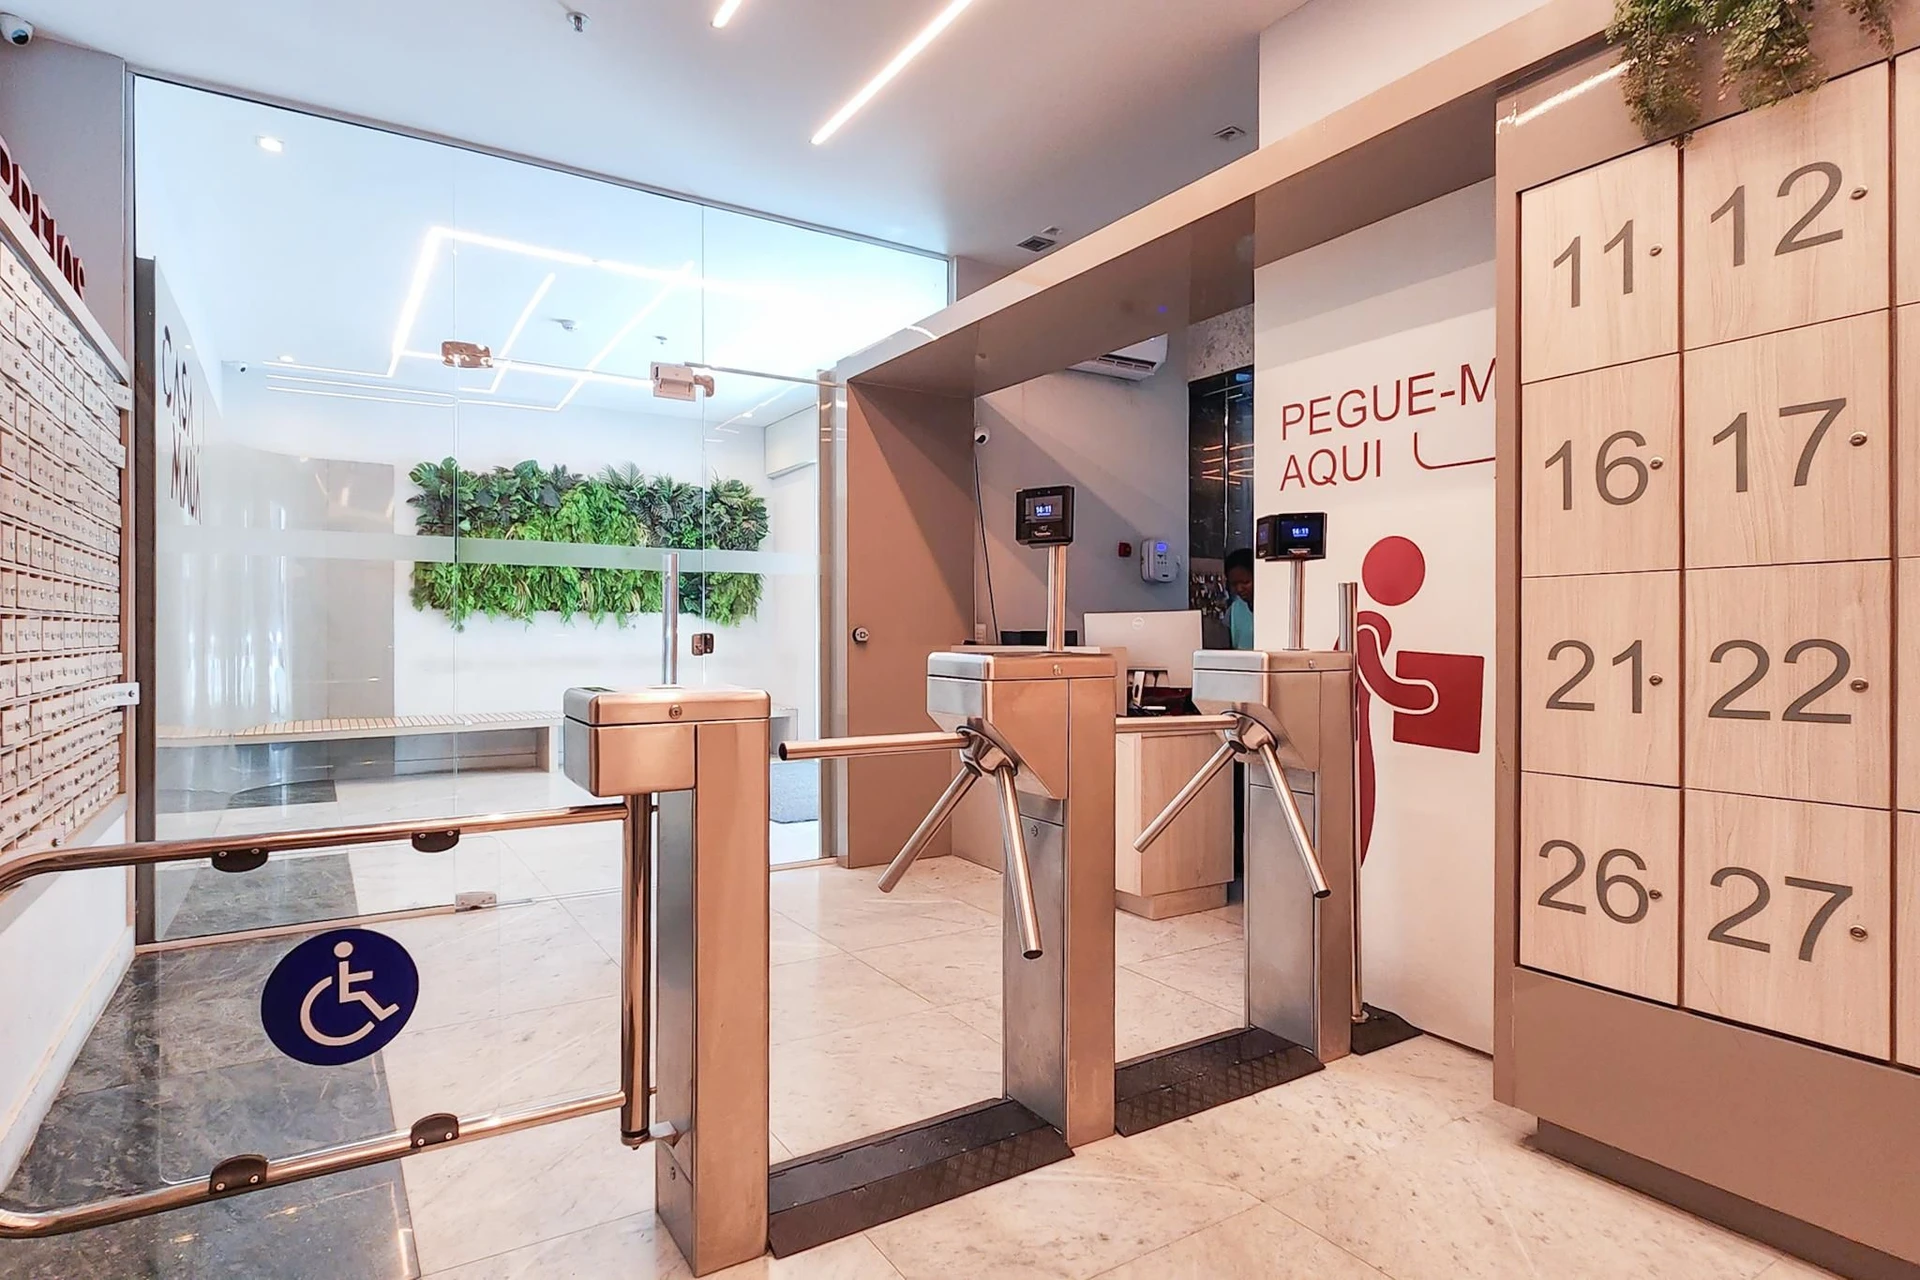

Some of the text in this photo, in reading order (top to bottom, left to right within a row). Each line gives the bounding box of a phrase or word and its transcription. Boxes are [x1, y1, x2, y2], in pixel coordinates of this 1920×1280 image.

[1710, 161, 1844, 268] 12
[1553, 219, 1634, 308] 11
[162, 325, 194, 448] CASA
[1281, 357, 1496, 441] PEGUE-M
[1279, 438, 1382, 491] AQUI
[1545, 430, 1650, 511] 16
[1713, 398, 1847, 493] 17
[1546, 639, 1643, 714] 21
[1708, 639, 1852, 724] 22
[1538, 839, 1650, 925] 26
[1708, 866, 1853, 962] 27
